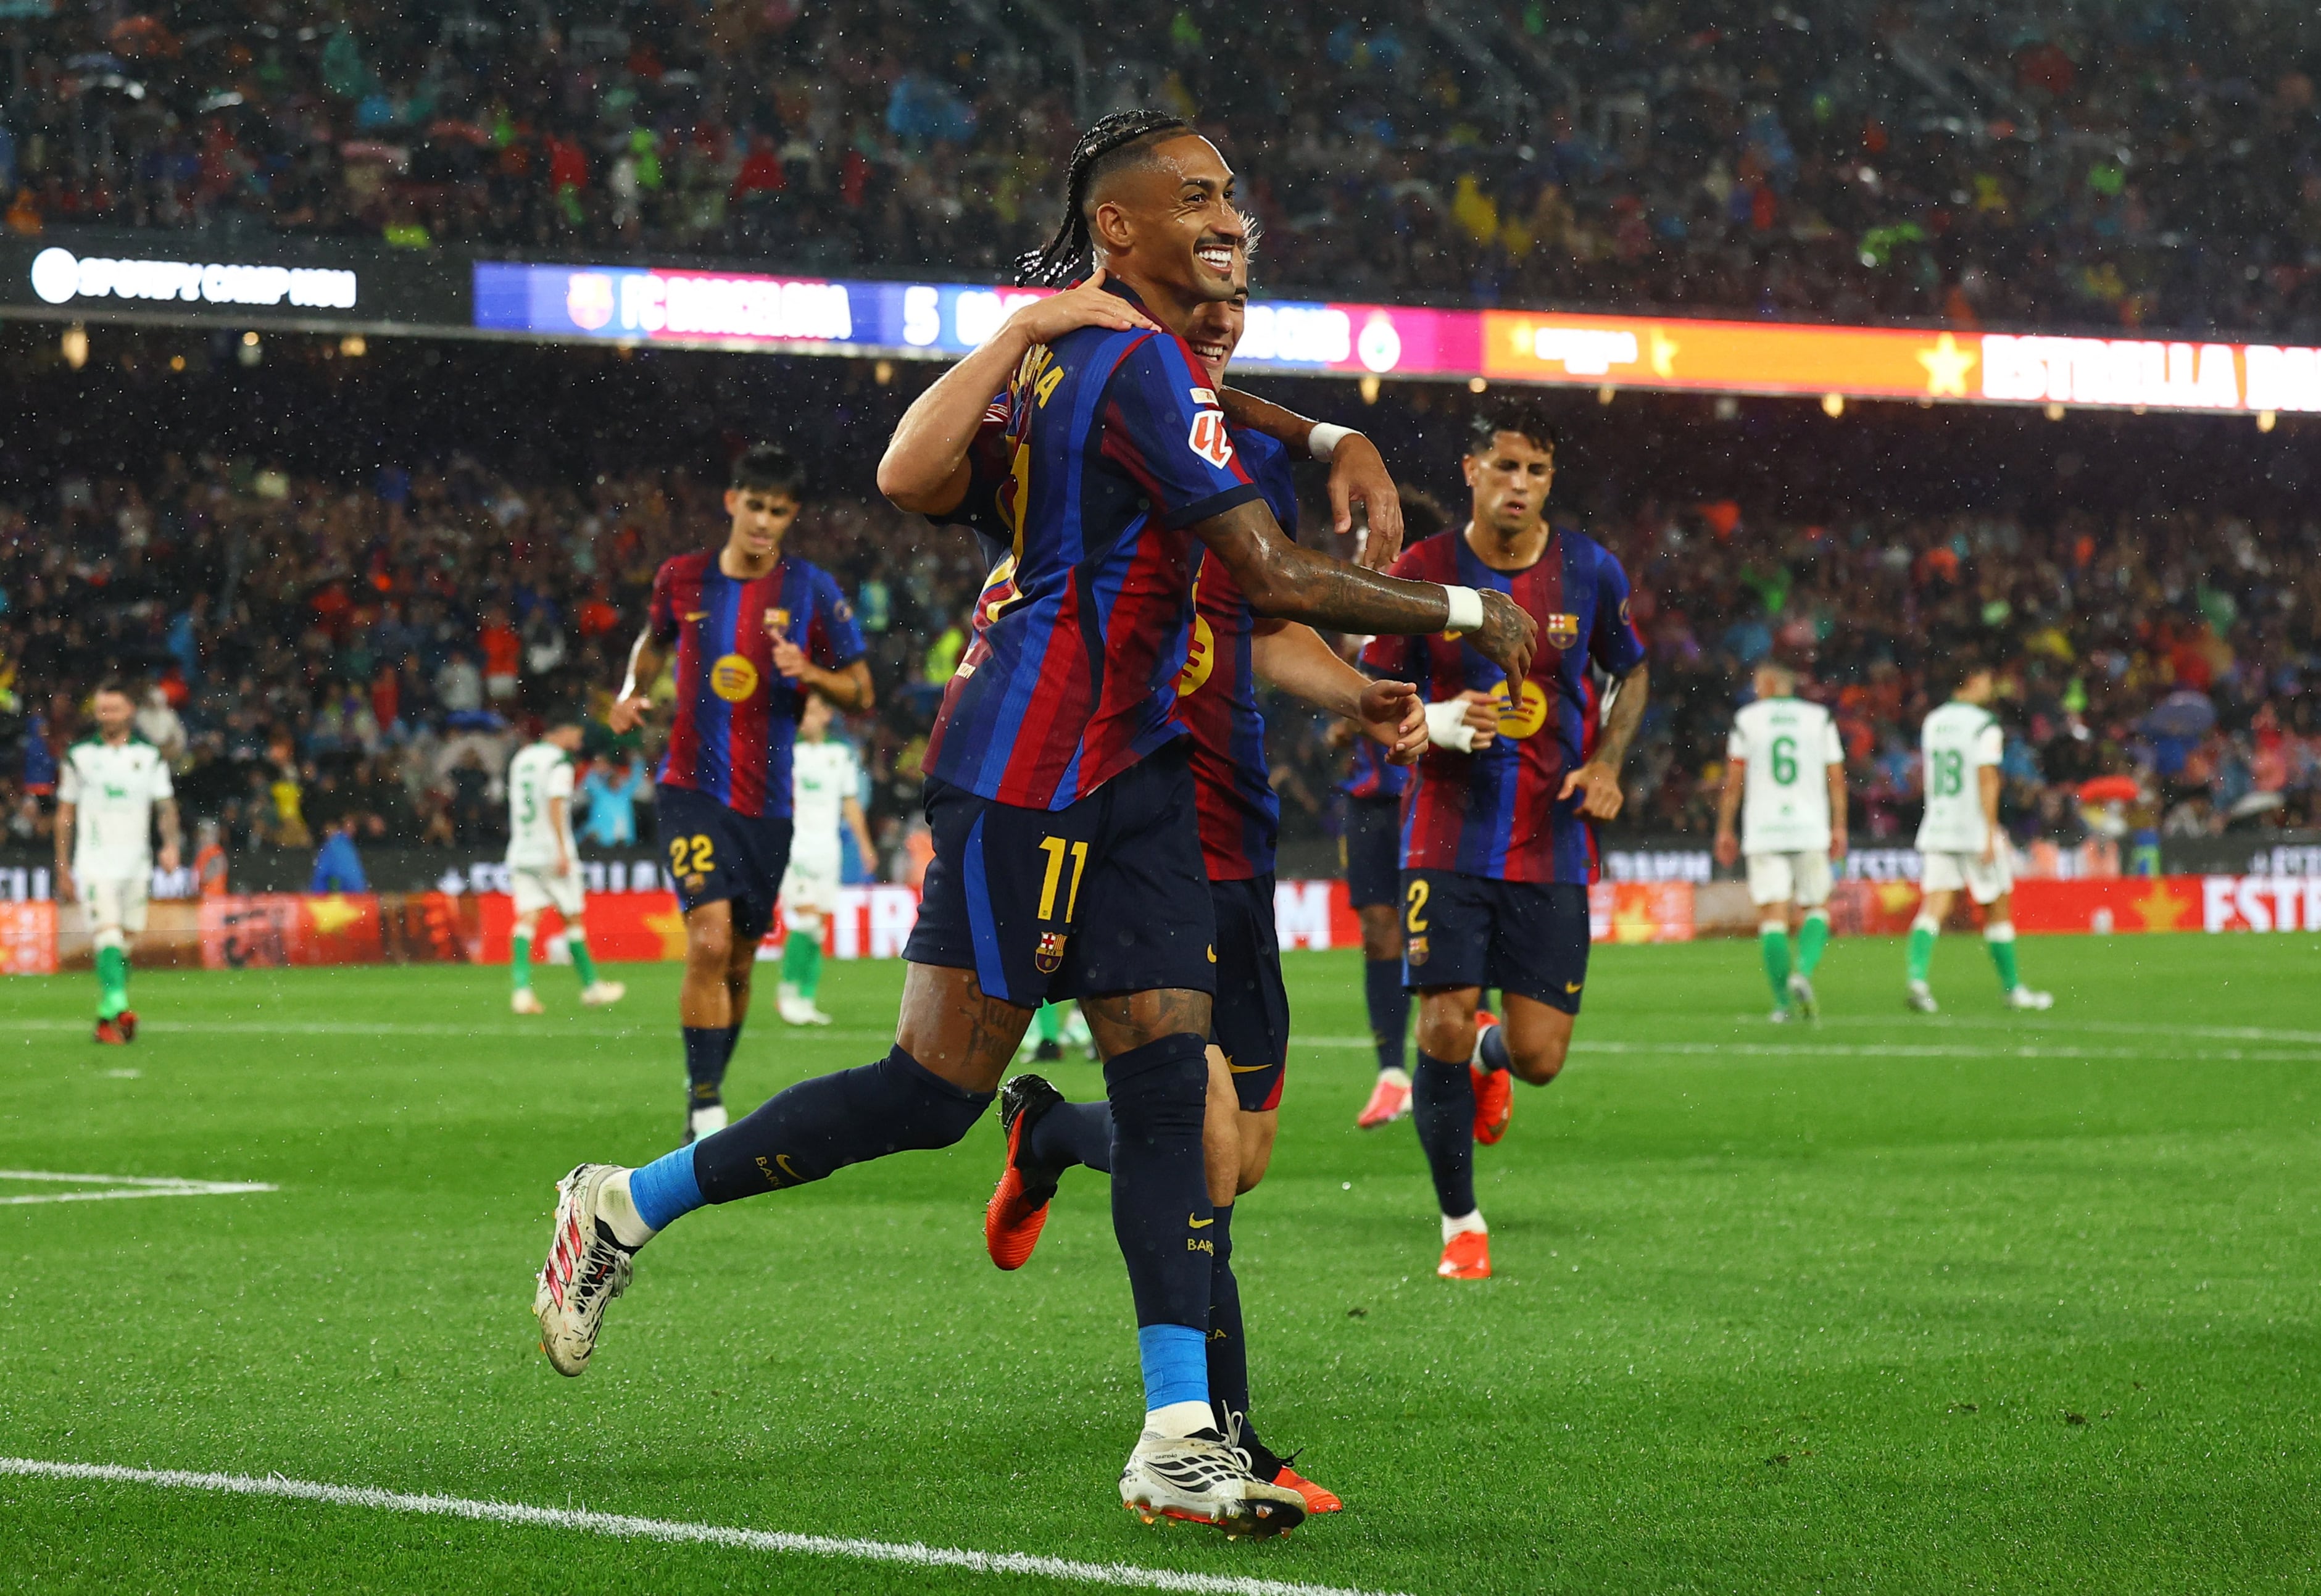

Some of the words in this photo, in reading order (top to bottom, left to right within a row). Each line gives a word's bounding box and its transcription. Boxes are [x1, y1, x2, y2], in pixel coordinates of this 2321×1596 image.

[903, 286, 939, 345] 5
[1771, 736, 1798, 786] 6
[669, 834, 716, 879] 22
[1037, 836, 1089, 923] 11
[1274, 880, 1331, 950] M
[1406, 879, 1430, 933] 2
[2203, 875, 2321, 933] ESTR
[755, 1156, 783, 1187] BAR
[1187, 1238, 1214, 1257] BARÇ
